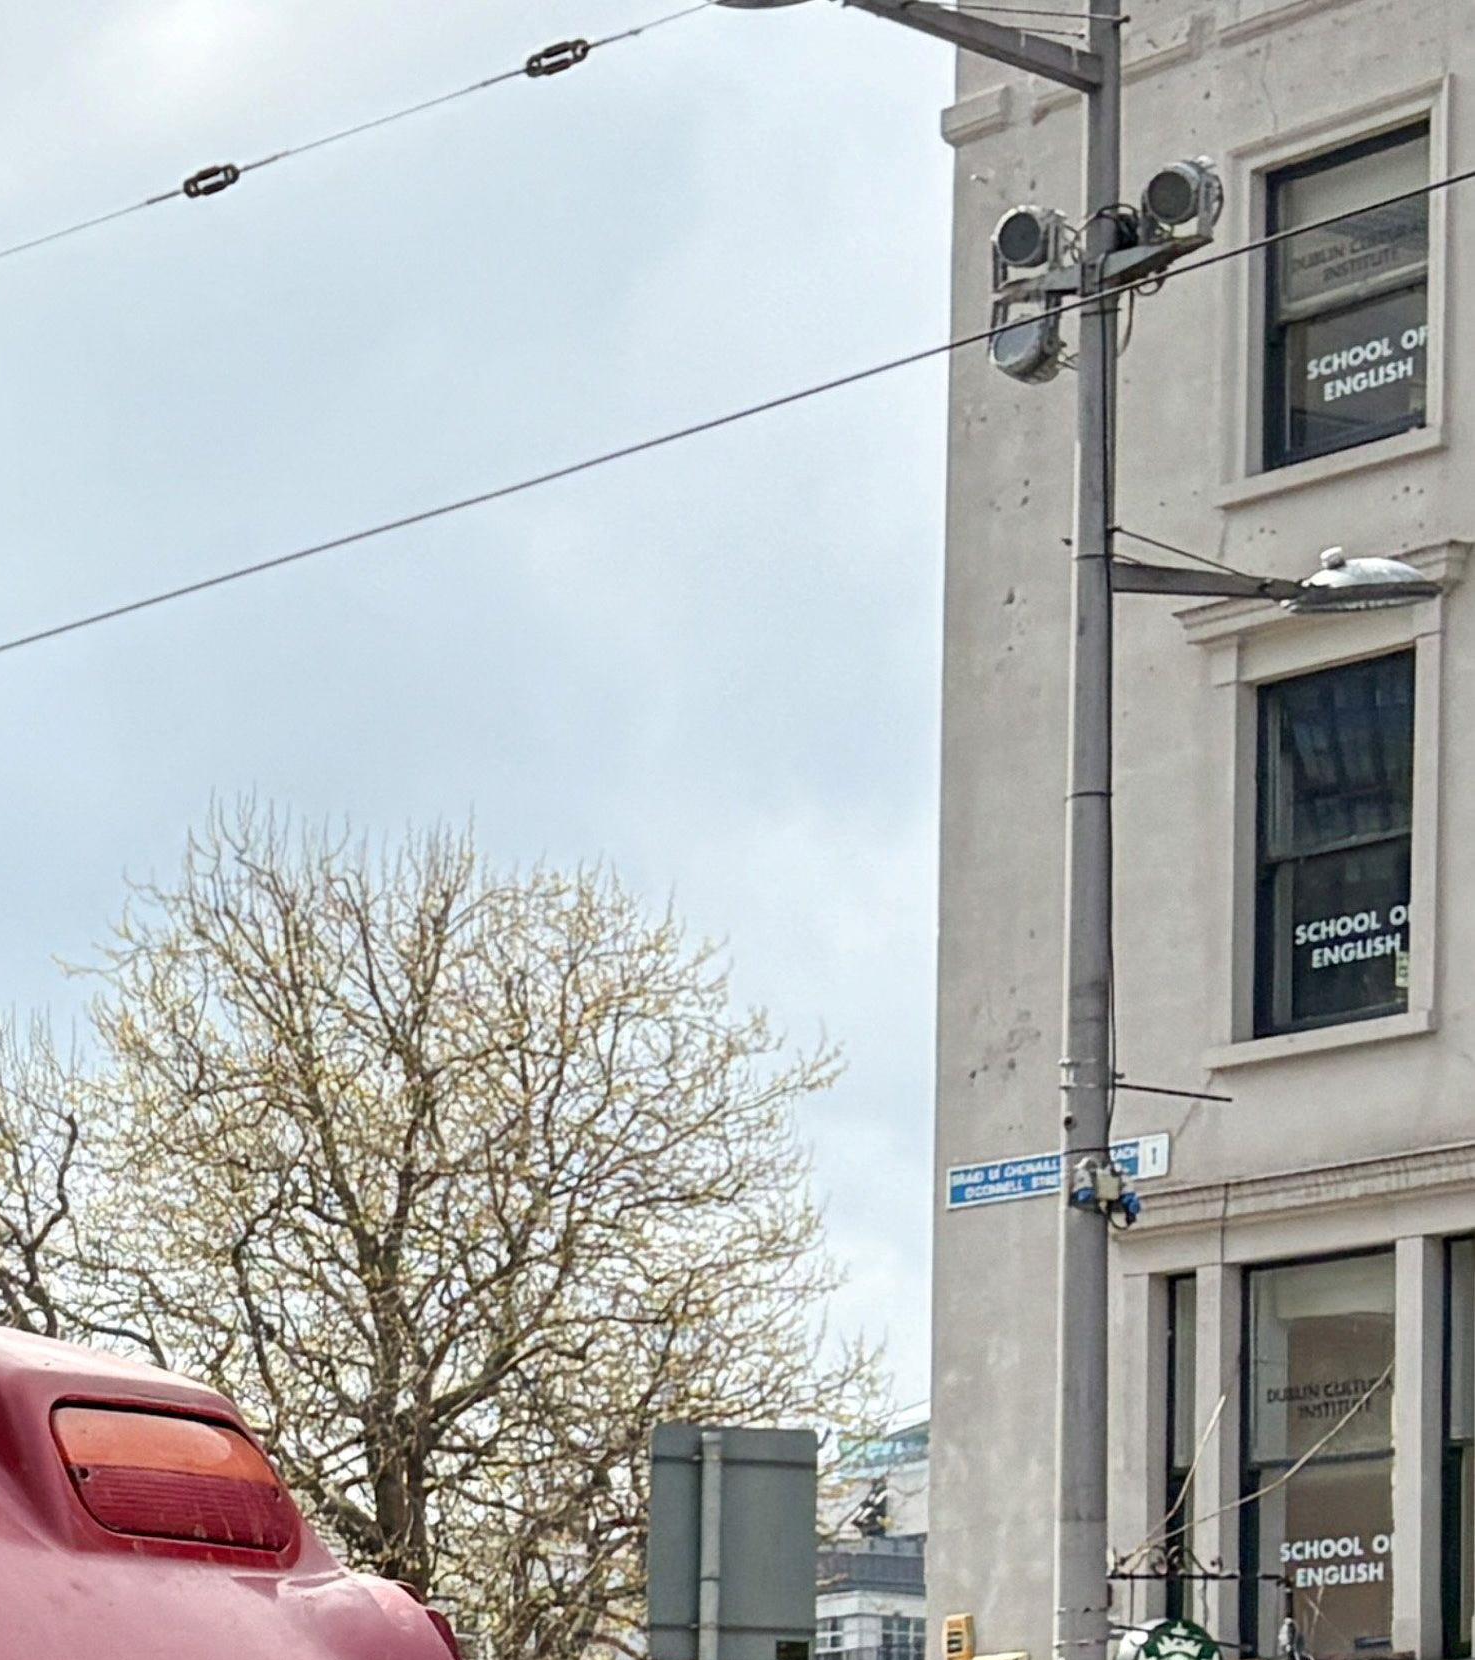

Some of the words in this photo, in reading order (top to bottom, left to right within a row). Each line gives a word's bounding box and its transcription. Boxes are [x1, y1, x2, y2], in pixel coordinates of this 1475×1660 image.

[1307, 337, 1393, 380] SCHOOL
[1324, 357, 1414, 401] ENGLISH
[1295, 910, 1381, 946] SCHOOL
[1389, 904, 1409, 926] O
[1311, 933, 1401, 969] ENGLISH
[1279, 1536, 1364, 1563] SCHOOL
[1372, 1534, 1394, 1555] O
[1296, 1562, 1384, 1588] ENGLISH
